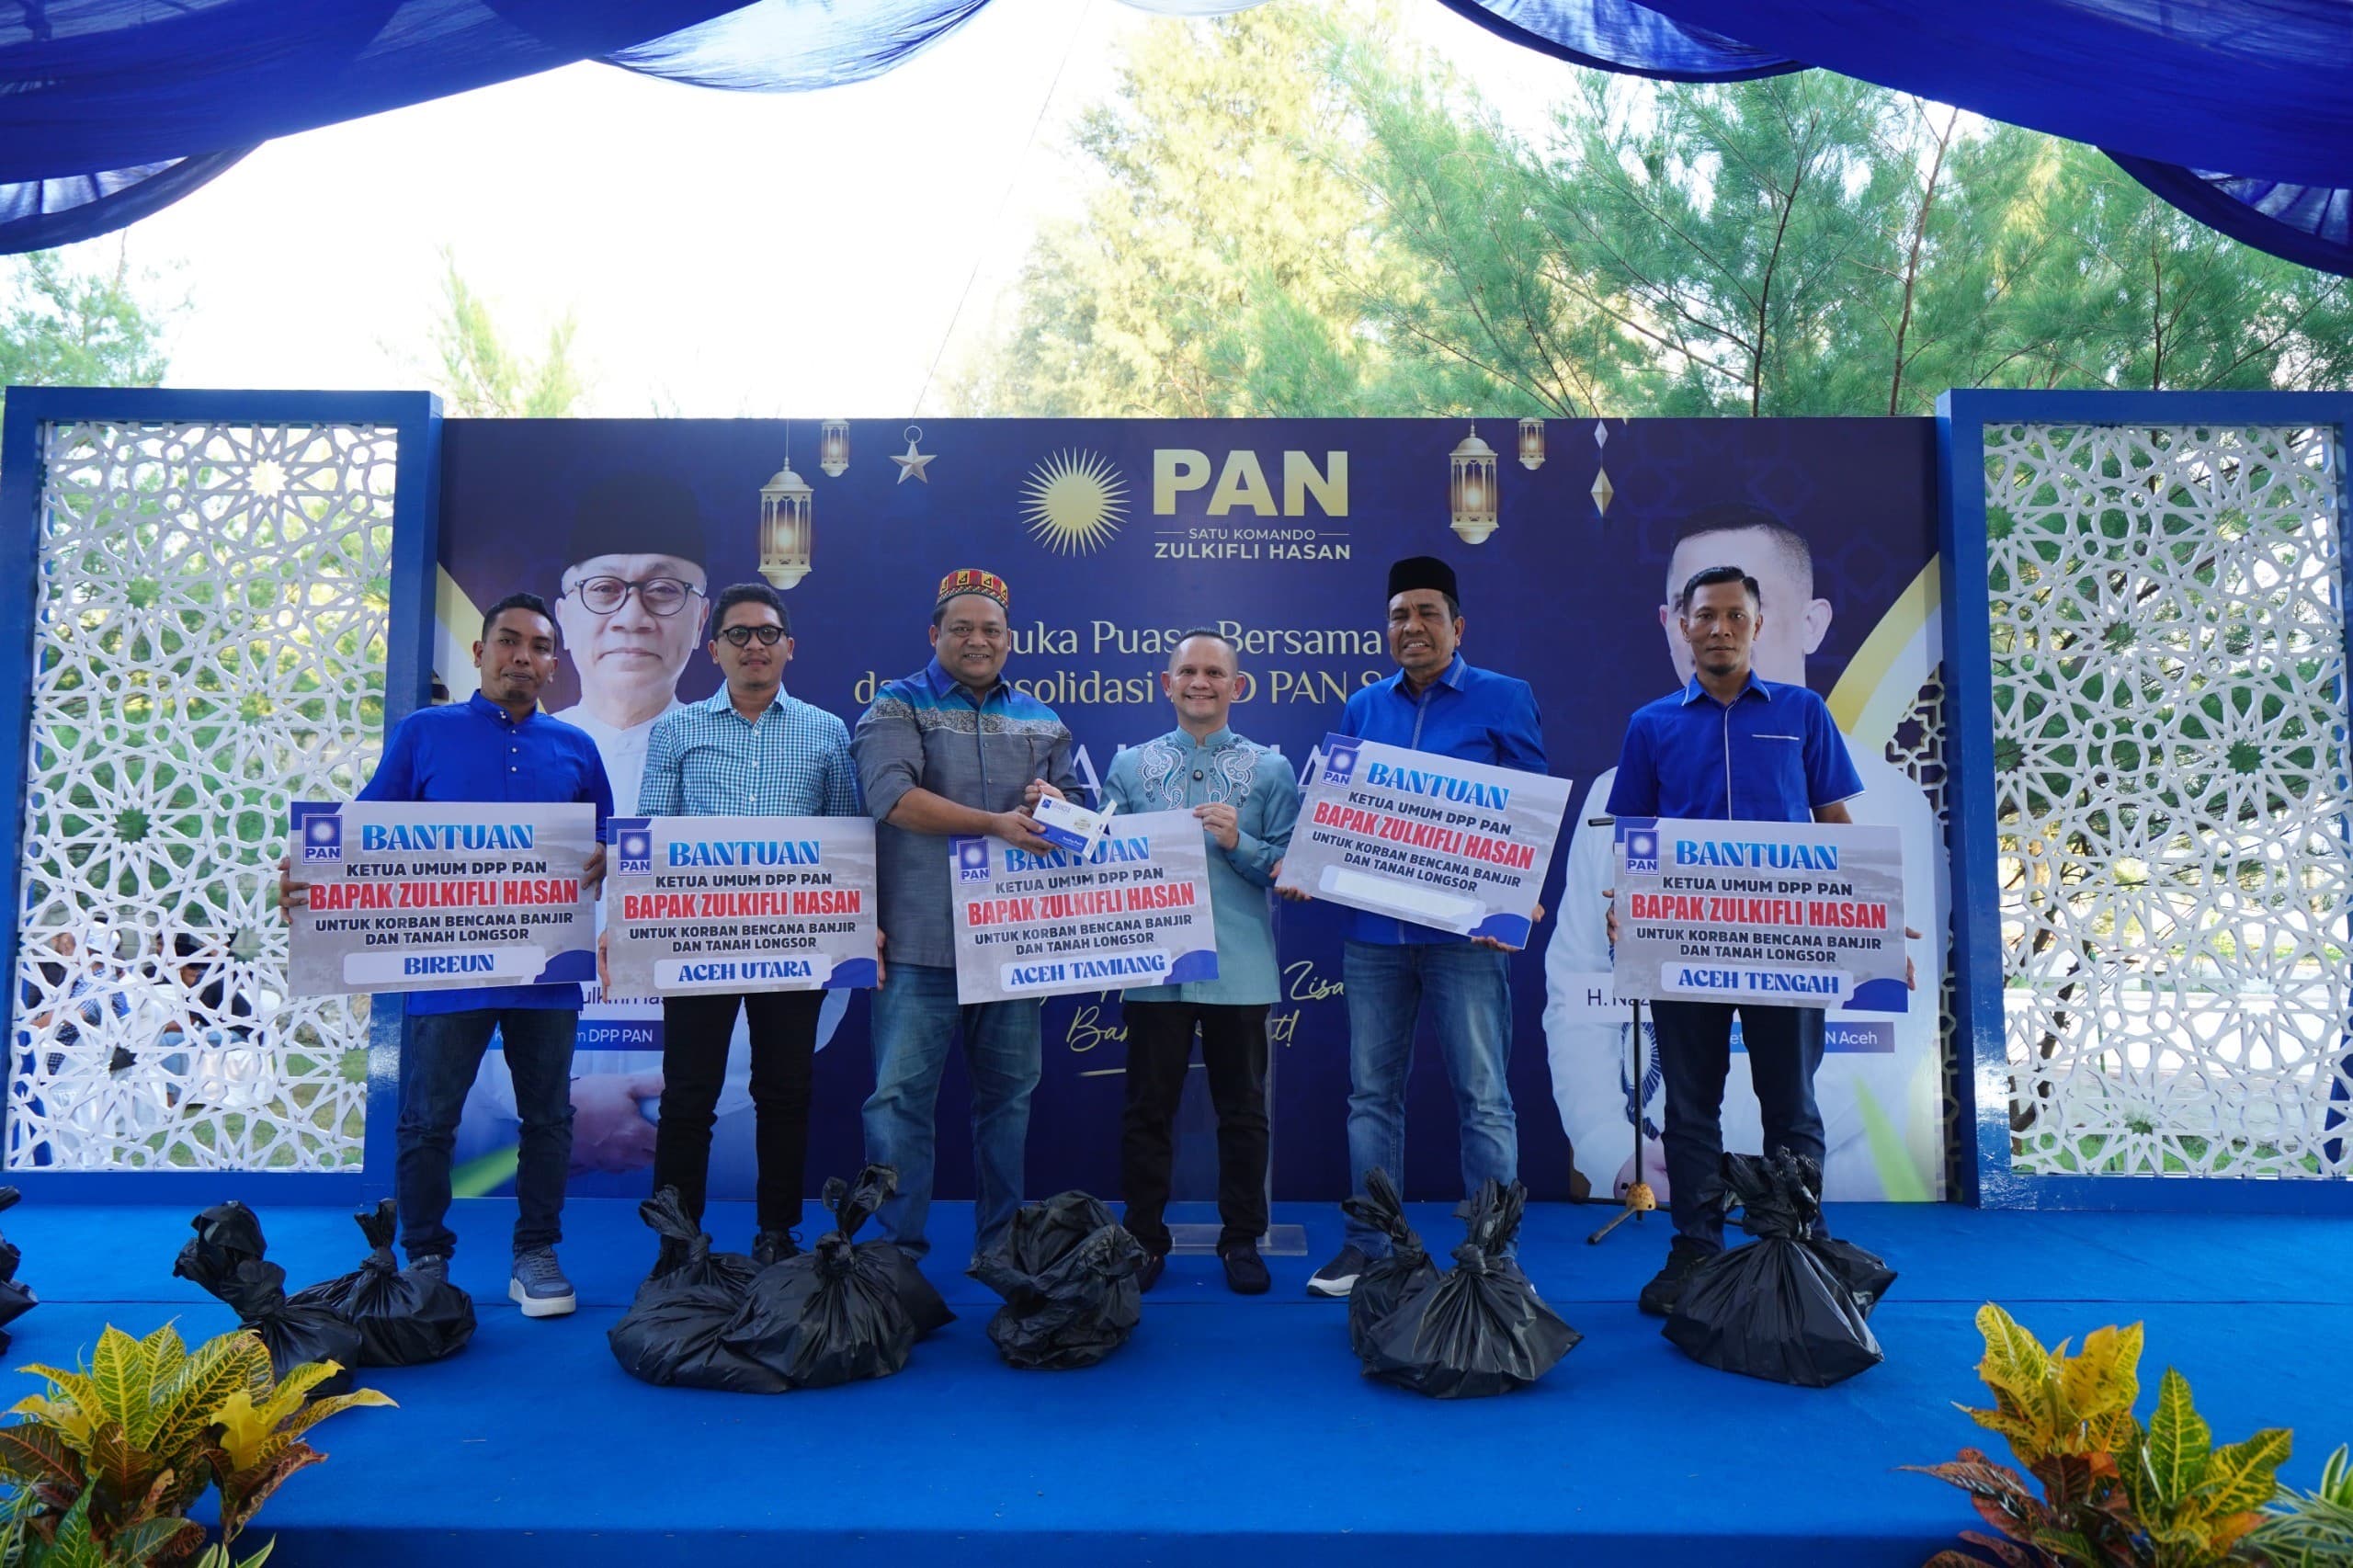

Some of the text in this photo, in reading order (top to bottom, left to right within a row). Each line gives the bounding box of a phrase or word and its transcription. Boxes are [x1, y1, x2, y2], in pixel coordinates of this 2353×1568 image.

[1154, 449, 1348, 517] PAN
[1188, 528, 1316, 540] SATU KOMANDO
[1154, 542, 1350, 560] ZULKIFLI HASAN
[1010, 620, 1382, 655] uka Puas Bersama
[1009, 670, 1154, 704] solidasi
[1267, 670, 1347, 704] PAN
[1323, 771, 1350, 785] PAN
[1366, 762, 1510, 811] BANTUAN
[1347, 791, 1511, 836] KETUA UMUM DPP PAN
[362, 824, 533, 850] BANTUAN
[1313, 801, 1536, 870] BAPAK ZULKIFLI HASAN
[304, 847, 340, 859] PAN
[669, 841, 819, 867] BANTUAN
[1312, 831, 1521, 888] UNTUK KORBAN BENCANA BANJIR
[1676, 840, 1838, 870] BANTUAN
[347, 861, 547, 877] KETUA UMUM DPP PAN
[620, 861, 651, 871] PAN
[961, 868, 990, 880] PAN
[1344, 853, 1478, 893] DAN TANAH LONGSOR
[1627, 859, 1657, 871] PAN
[655, 873, 832, 888] KETUA UMUM DPP PAN
[995, 868, 1164, 894] KETUA UMUM DPP PAN
[1663, 877, 1853, 896] KETUA UMUM DPP PAN
[310, 880, 578, 910] BAPAK ZULKIFLI HASAN
[624, 890, 860, 919] BAPAK ZULKIFLI HASAN
[967, 882, 1195, 926] BAPAK ZULKIFLI HASAN
[316, 913, 573, 931] UNTUK KORBAN BENCANA BANJIR
[1631, 893, 1886, 929] BAPAK ZULKIFLI HASAN
[366, 928, 529, 945] DAN TANAH LONGSOR
[630, 922, 856, 939] UNTUK KORBAN BENCANA BANJIR
[975, 915, 1192, 945] UNTUK KORBAN BENCANA BANJIR
[1636, 927, 1881, 950] UNTUK KORBAN BENCANA BANJIR
[673, 937, 816, 952] DAN TANAH LONGSOR
[1016, 932, 1154, 956] DAN TANAH LONGSOR
[1680, 944, 1836, 963] DAN TANAH LONGSOR
[404, 954, 494, 975] BIREUN
[678, 960, 812, 982] ACEH UTARA
[1010, 954, 1165, 986] ACEH TAMIANG
[1678, 968, 1838, 994] ACEH TENGAH
[1587, 988, 1608, 1006] H.
[588, 1028, 620, 1042] DPP
[622, 1028, 653, 1042] PAN
[1839, 1030, 1878, 1045] Aceh
